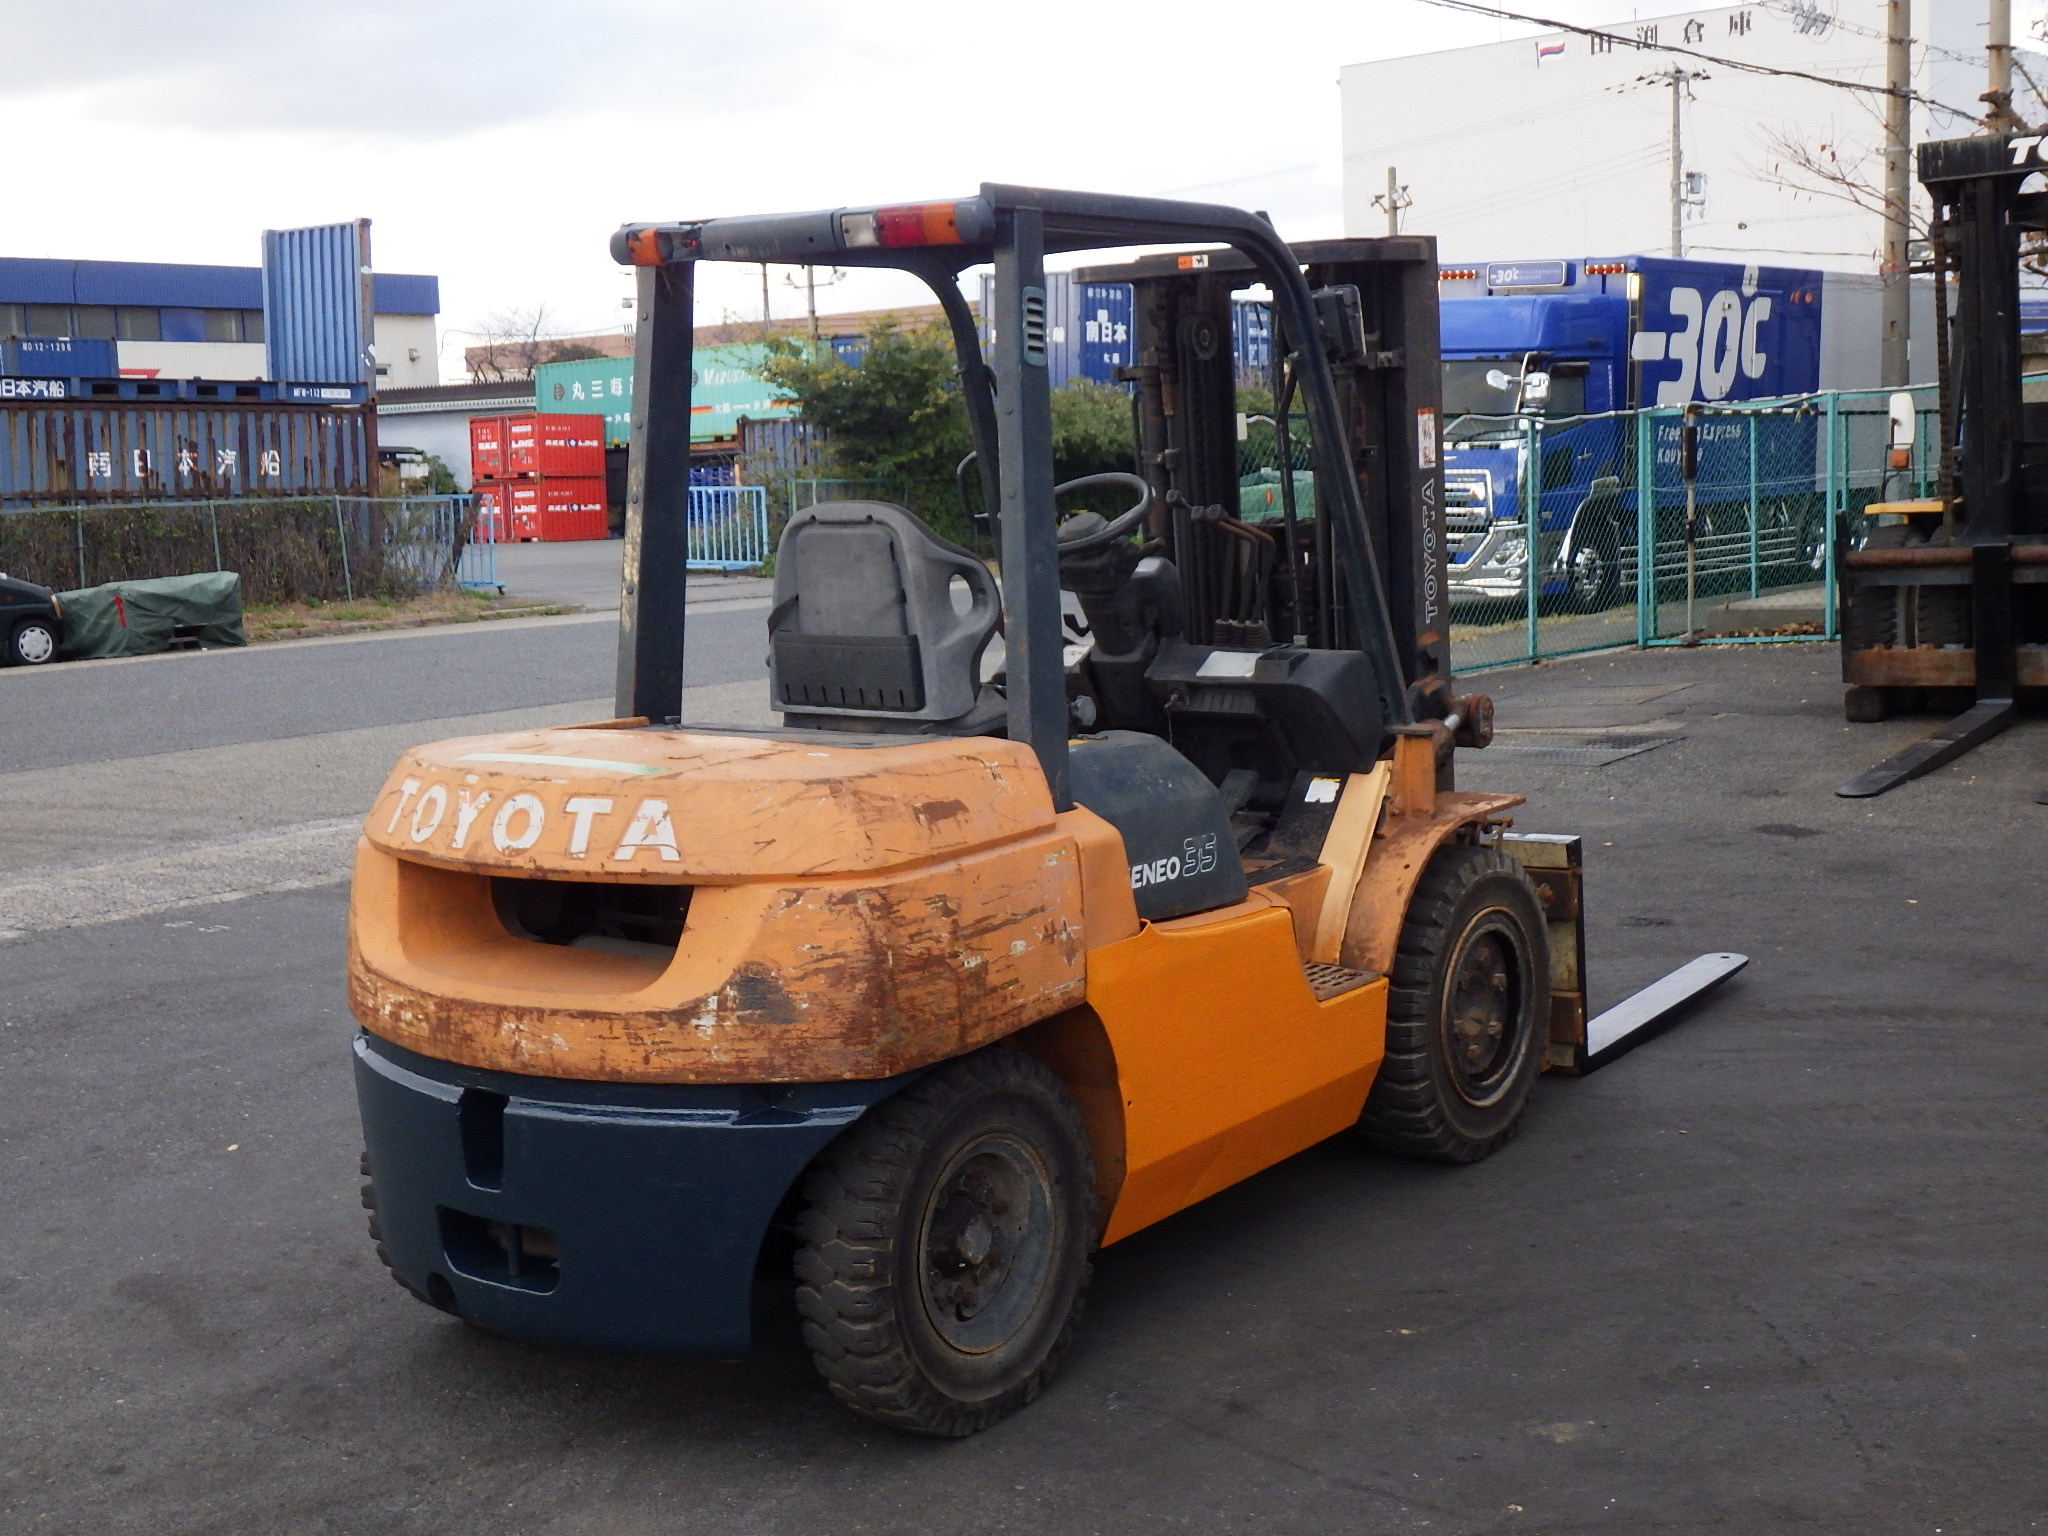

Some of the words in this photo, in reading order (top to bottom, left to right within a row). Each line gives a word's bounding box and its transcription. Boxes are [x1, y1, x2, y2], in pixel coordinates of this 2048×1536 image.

[0, 379, 65, 398] 日本汽船
[1702, 422, 1741, 443] Express
[1421, 477, 1439, 624] TOYOTA
[387, 777, 683, 862] TOYOTA
[1128, 856, 1181, 889] ENEO
[1182, 832, 1218, 877] 35
